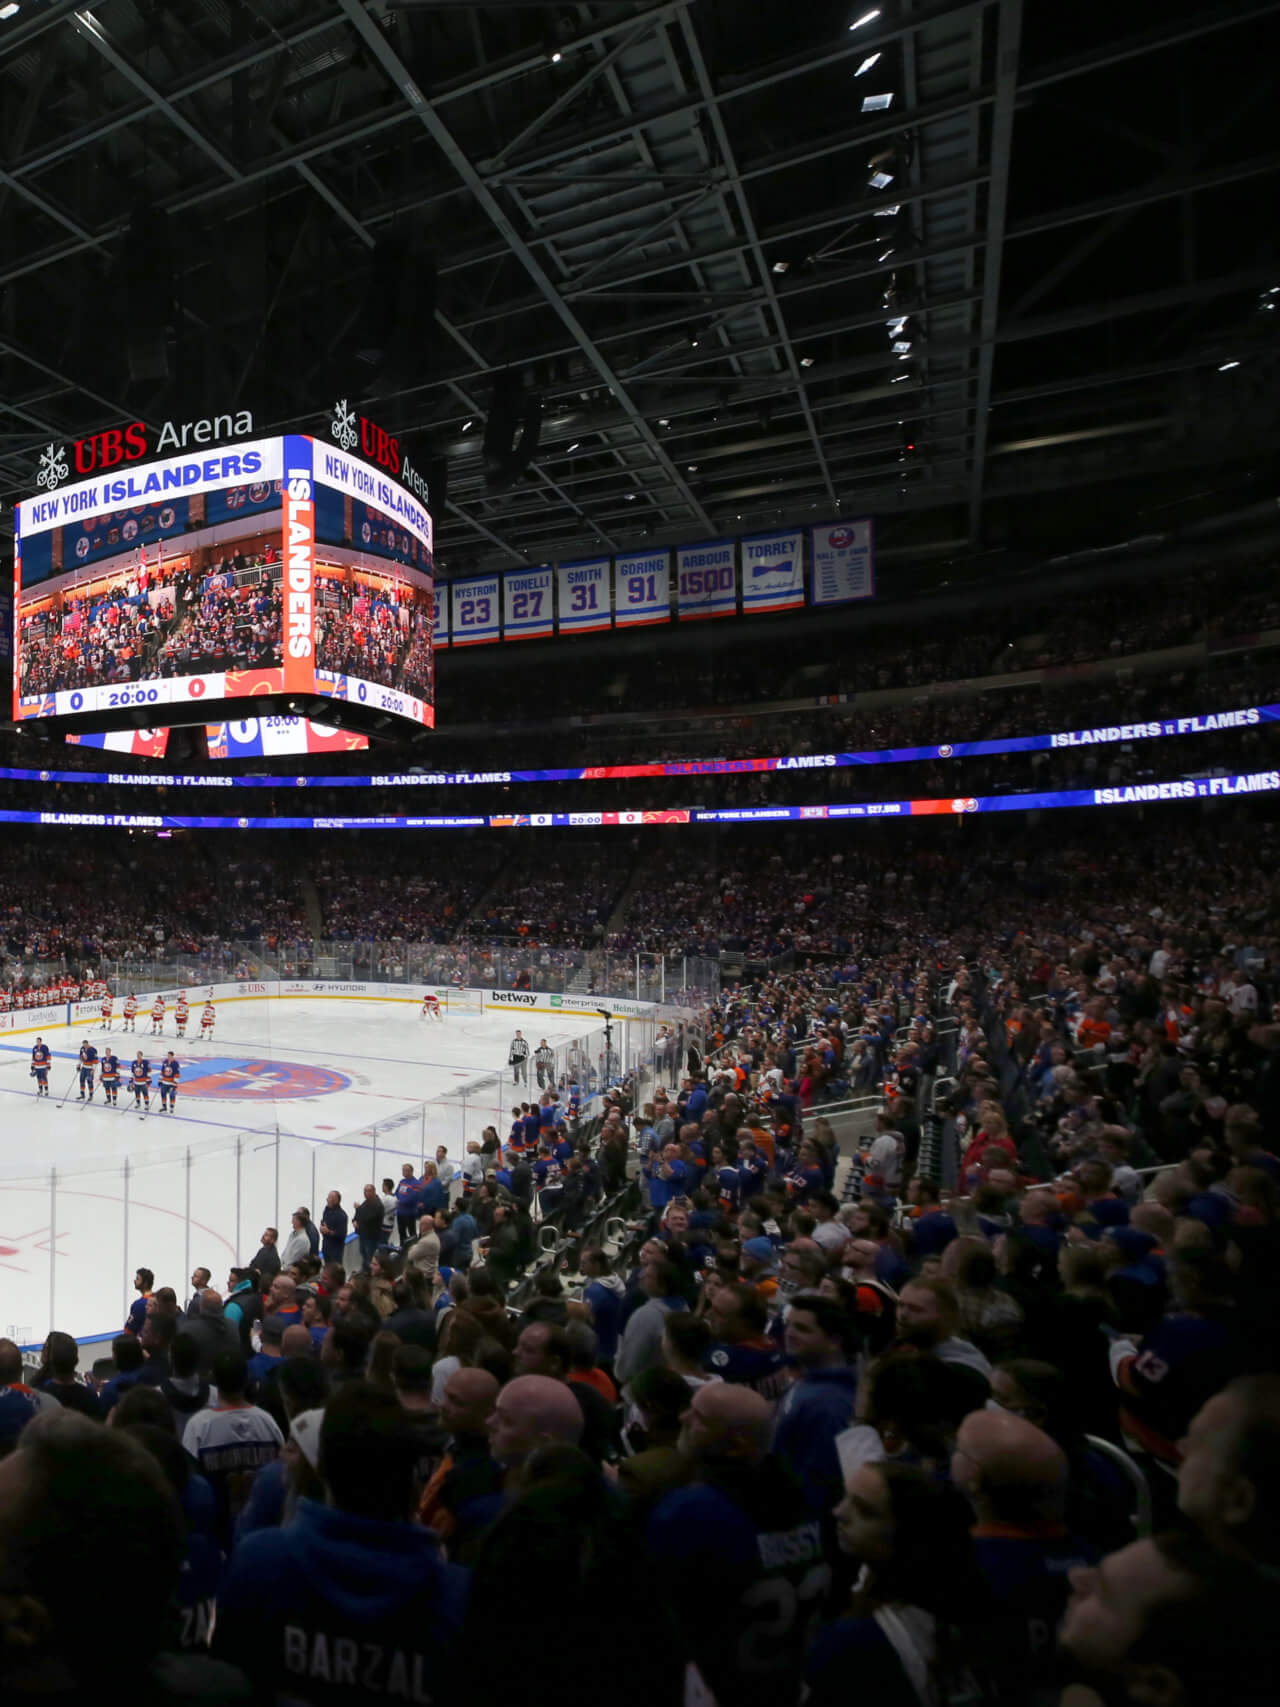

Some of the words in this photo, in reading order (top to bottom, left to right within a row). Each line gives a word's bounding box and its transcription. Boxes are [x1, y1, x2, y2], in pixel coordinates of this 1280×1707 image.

[72, 421, 147, 474] UBS
[156, 410, 253, 453] Arena
[360, 416, 400, 475] UBS
[402, 455, 429, 505] Arena
[32, 498, 60, 525] NEW
[62, 487, 98, 515] YORK
[104, 450, 263, 505] ISLANDERS
[325, 453, 350, 483] NEW
[352, 465, 375, 498] YORK
[377, 481, 429, 540] ISLANDERS
[287, 468, 312, 658] ISLANDERS
[682, 551, 730, 569] ARBOUR
[747, 540, 796, 559] TORREY
[567, 567, 602, 584] SMITH
[620, 559, 664, 576] GORING
[679, 567, 734, 595] 1500
[455, 583, 496, 599] NYSTROM
[508, 575, 549, 592] TONELLI
[627, 574, 657, 603] 91
[512, 591, 543, 618] 27
[570, 583, 598, 612] 31
[461, 598, 491, 625] 23
[70, 692, 84, 710] 0
[108, 688, 158, 707] 20:00
[188, 678, 206, 698] 0
[358, 682, 367, 702] 0
[381, 694, 404, 713] 20:00
[413, 701, 419, 718] 0
[266, 716, 300, 728] 20:00
[1051, 722, 1161, 748] ISLANDERS
[1177, 708, 1260, 734] FLAMES
[108, 774, 175, 786] ISLANDERS
[183, 775, 233, 786] FLAMES
[370, 774, 446, 786] ISLANDERS
[455, 772, 511, 784] FLAMES
[1093, 781, 1196, 805] ISLANDERS
[1209, 770, 1280, 795] FLAMES
[40, 812, 106, 825] ISLANDERS
[113, 815, 163, 826] FLAMES
[538, 815, 545, 825] 0
[571, 816, 601, 824] 20:00
[627, 814, 635, 823] 0
[248, 983, 265, 992] UBS
[327, 984, 367, 992] HYUNDAI
[492, 991, 537, 1006] betway
[283, 1623, 435, 1705] BARZAL
